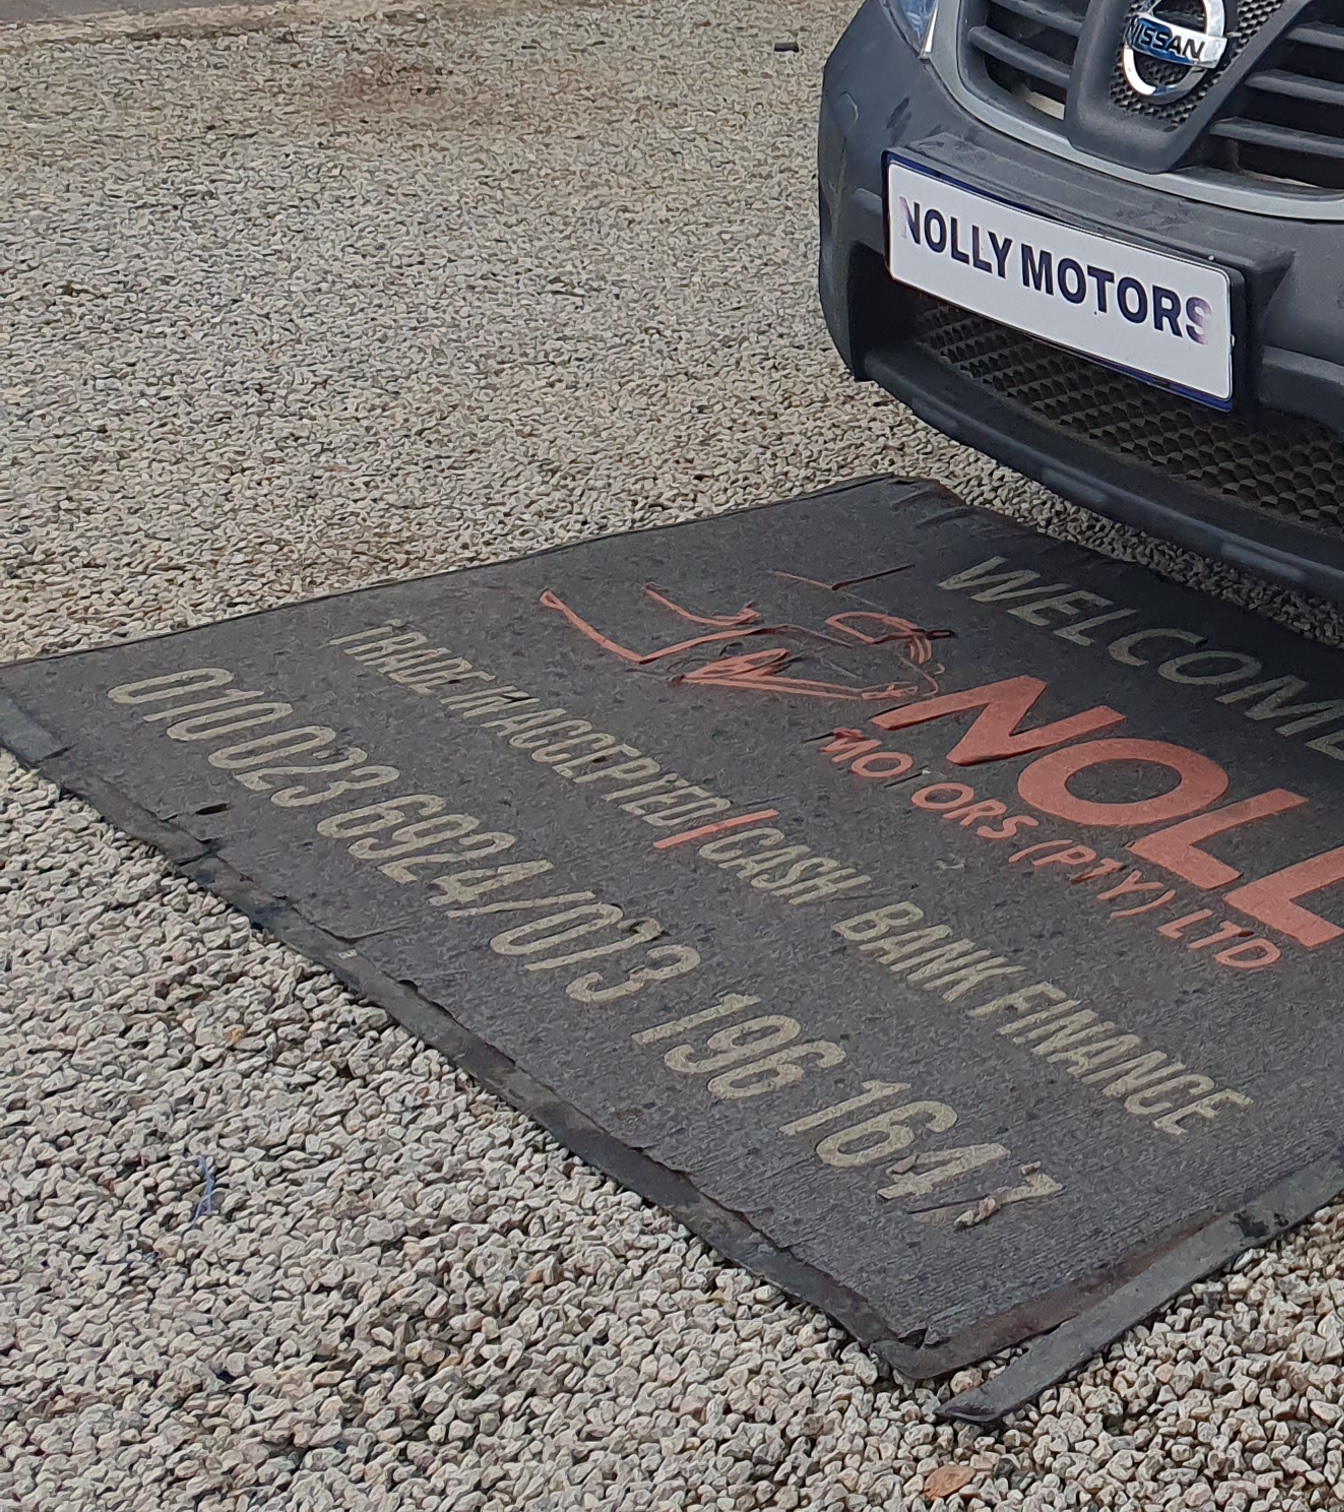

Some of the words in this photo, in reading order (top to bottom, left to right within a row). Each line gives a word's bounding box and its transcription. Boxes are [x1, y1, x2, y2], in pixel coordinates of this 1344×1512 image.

[1125, 17, 1206, 59] NISSAN
[899, 196, 1013, 281] NOLLY
[1021, 242, 1213, 346] MOTORS
[107, 667, 294, 743] 010
[207, 725, 400, 807] 023
[631, 992, 847, 1100] 196
[780, 1080, 1066, 1226] 1647
[330, 620, 497, 695] TRADE
[440, 685, 541, 720] IN
[831, 900, 1028, 1003] BANK
[968, 981, 1254, 1138] FINANCE
[819, 727, 1040, 839] MOORS
[1008, 839, 1176, 920] (PTY)
[1156, 908, 1282, 969] LTD
